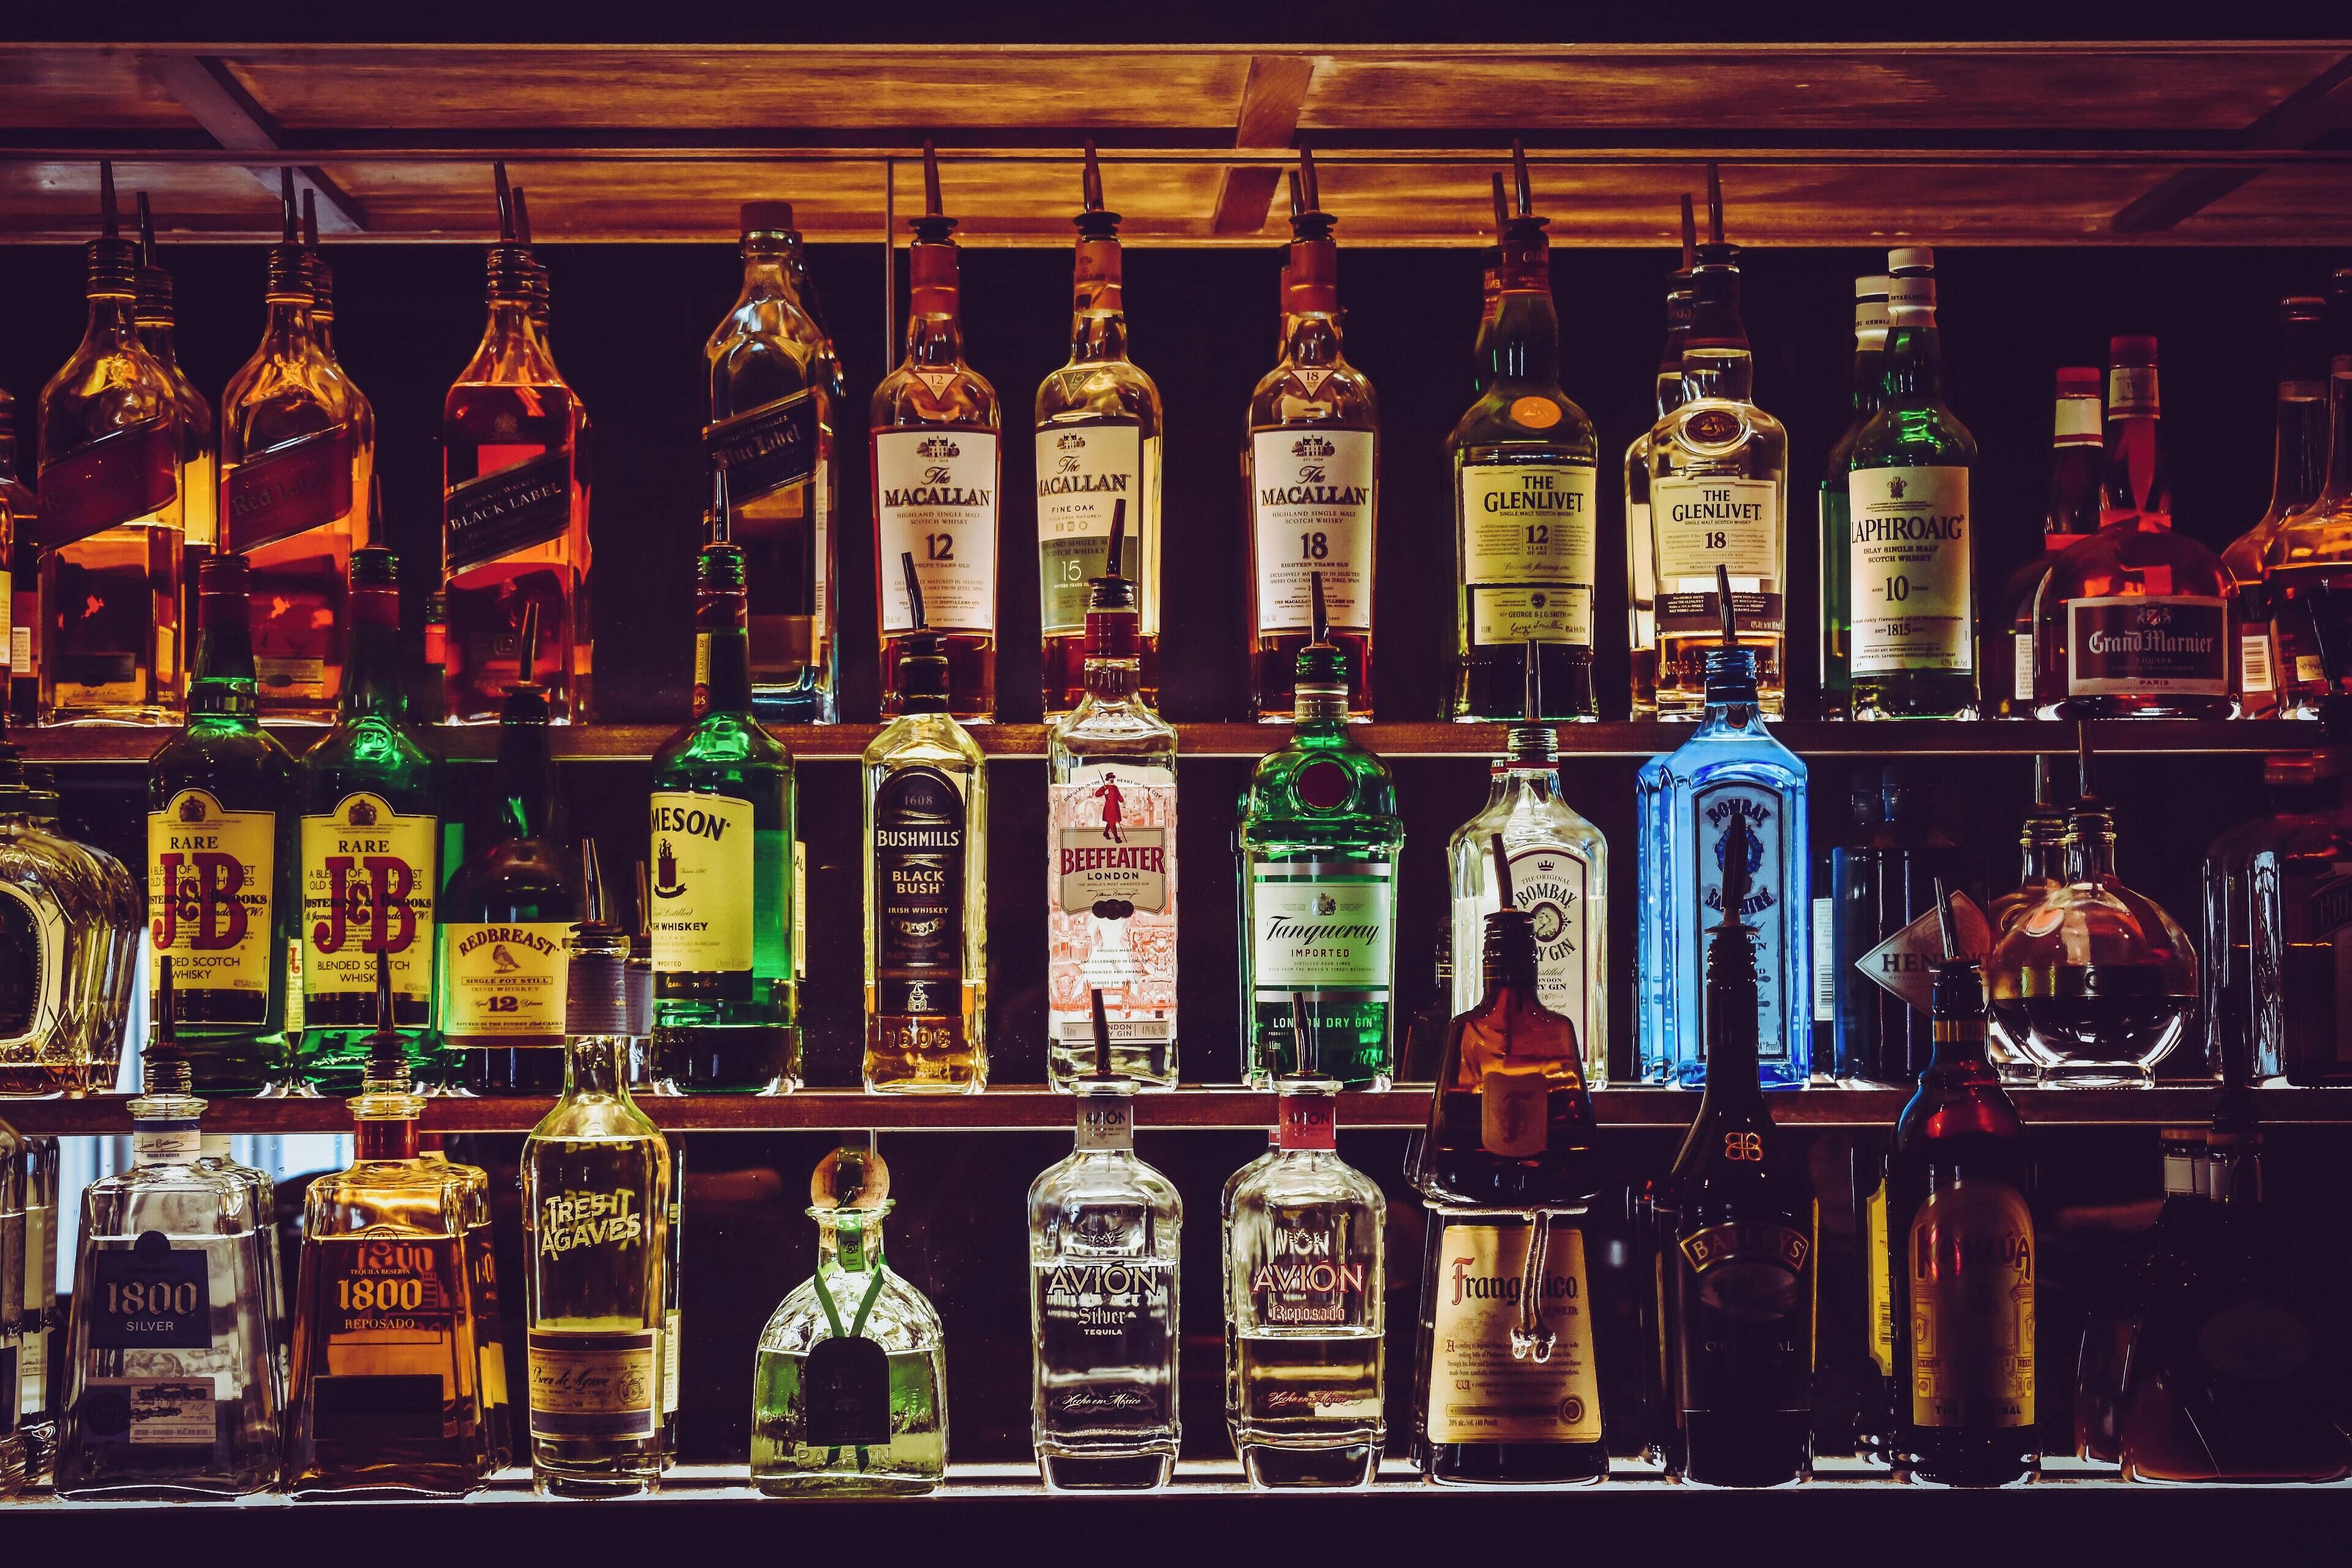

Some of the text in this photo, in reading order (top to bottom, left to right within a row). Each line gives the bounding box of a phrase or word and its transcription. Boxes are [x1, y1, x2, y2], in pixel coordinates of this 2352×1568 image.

[931, 374, 944, 385] 12
[1072, 374, 1085, 383] 15
[1306, 371, 1319, 382] 18
[1056, 455, 1081, 475] The
[1295, 465, 1326, 484] The
[921, 466, 951, 485] The
[1521, 476, 1553, 489] THE
[884, 487, 990, 508] MACALLAN
[1261, 486, 1370, 507] MACALLAN
[1484, 492, 1584, 513] GLENLIVET
[1703, 490, 1730, 502] THE
[450, 503, 505, 532] BLACK
[508, 482, 562, 509] LABEL
[1052, 505, 1071, 514] FINE
[1672, 503, 1762, 522] GLENLIVET
[1525, 524, 1549, 544] 12
[1852, 516, 1962, 544] LAPHROAIG
[925, 533, 954, 560] 12
[1300, 532, 1329, 560] 18
[1705, 532, 1727, 549] 18
[1062, 560, 1082, 582] 15
[1885, 575, 1909, 601] 10
[1887, 624, 1911, 636] 1815
[2089, 630, 2214, 654] Grand Marnier
[905, 796, 933, 805] 1608
[1064, 785, 1085, 802] DISTILLED
[1152, 790, 1163, 799] CITY
[1705, 798, 1771, 828] BOMBAY
[651, 807, 726, 842] MESON
[170, 836, 219, 849] RARE
[338, 840, 390, 853] RARE
[877, 830, 959, 846] BUSHMILLS
[1060, 846, 1166, 876] BEEFEATER
[309, 881, 326, 890] OLD
[892, 871, 944, 881] BLACK
[1087, 872, 1139, 880] LONDON
[1521, 874, 1570, 885] THE ORIGINAL
[896, 883, 940, 894] BUSH
[1515, 883, 1578, 909] BOMBAY
[661, 922, 709, 931] WHISKEY
[1266, 915, 1379, 946] Tanqueray
[458, 928, 556, 957] REDBREAST
[1548, 938, 1577, 962] GIN
[193, 957, 240, 967] SCOTCH
[1291, 949, 1349, 957] IMPORTED
[172, 970, 211, 979] WHISKY
[317, 960, 361, 970] BLENDED
[488, 996, 518, 1012] 12
[1326, 1017, 1350, 1028] DRY
[1355, 1017, 1373, 1028] GIN
[1272, 1041, 1281, 1050] Litre
[545, 1194, 607, 1235] TRES
[540, 1213, 641, 1261] AGAVES
[1692, 1229, 1805, 1261] BAILEYS
[1046, 1260, 1158, 1296] AVIÓN
[1252, 1258, 1365, 1293] AVIÓN
[107, 1281, 197, 1315] 1800
[337, 1278, 423, 1311] 1800
[1077, 1307, 1126, 1326] Silver
[1269, 1303, 1345, 1323] Reposado
[126, 1321, 175, 1331] SILVER
[345, 1318, 415, 1329] REPOSADO
[1062, 1393, 1091, 1411] Hecho
[1268, 1391, 1297, 1409] Hecho
